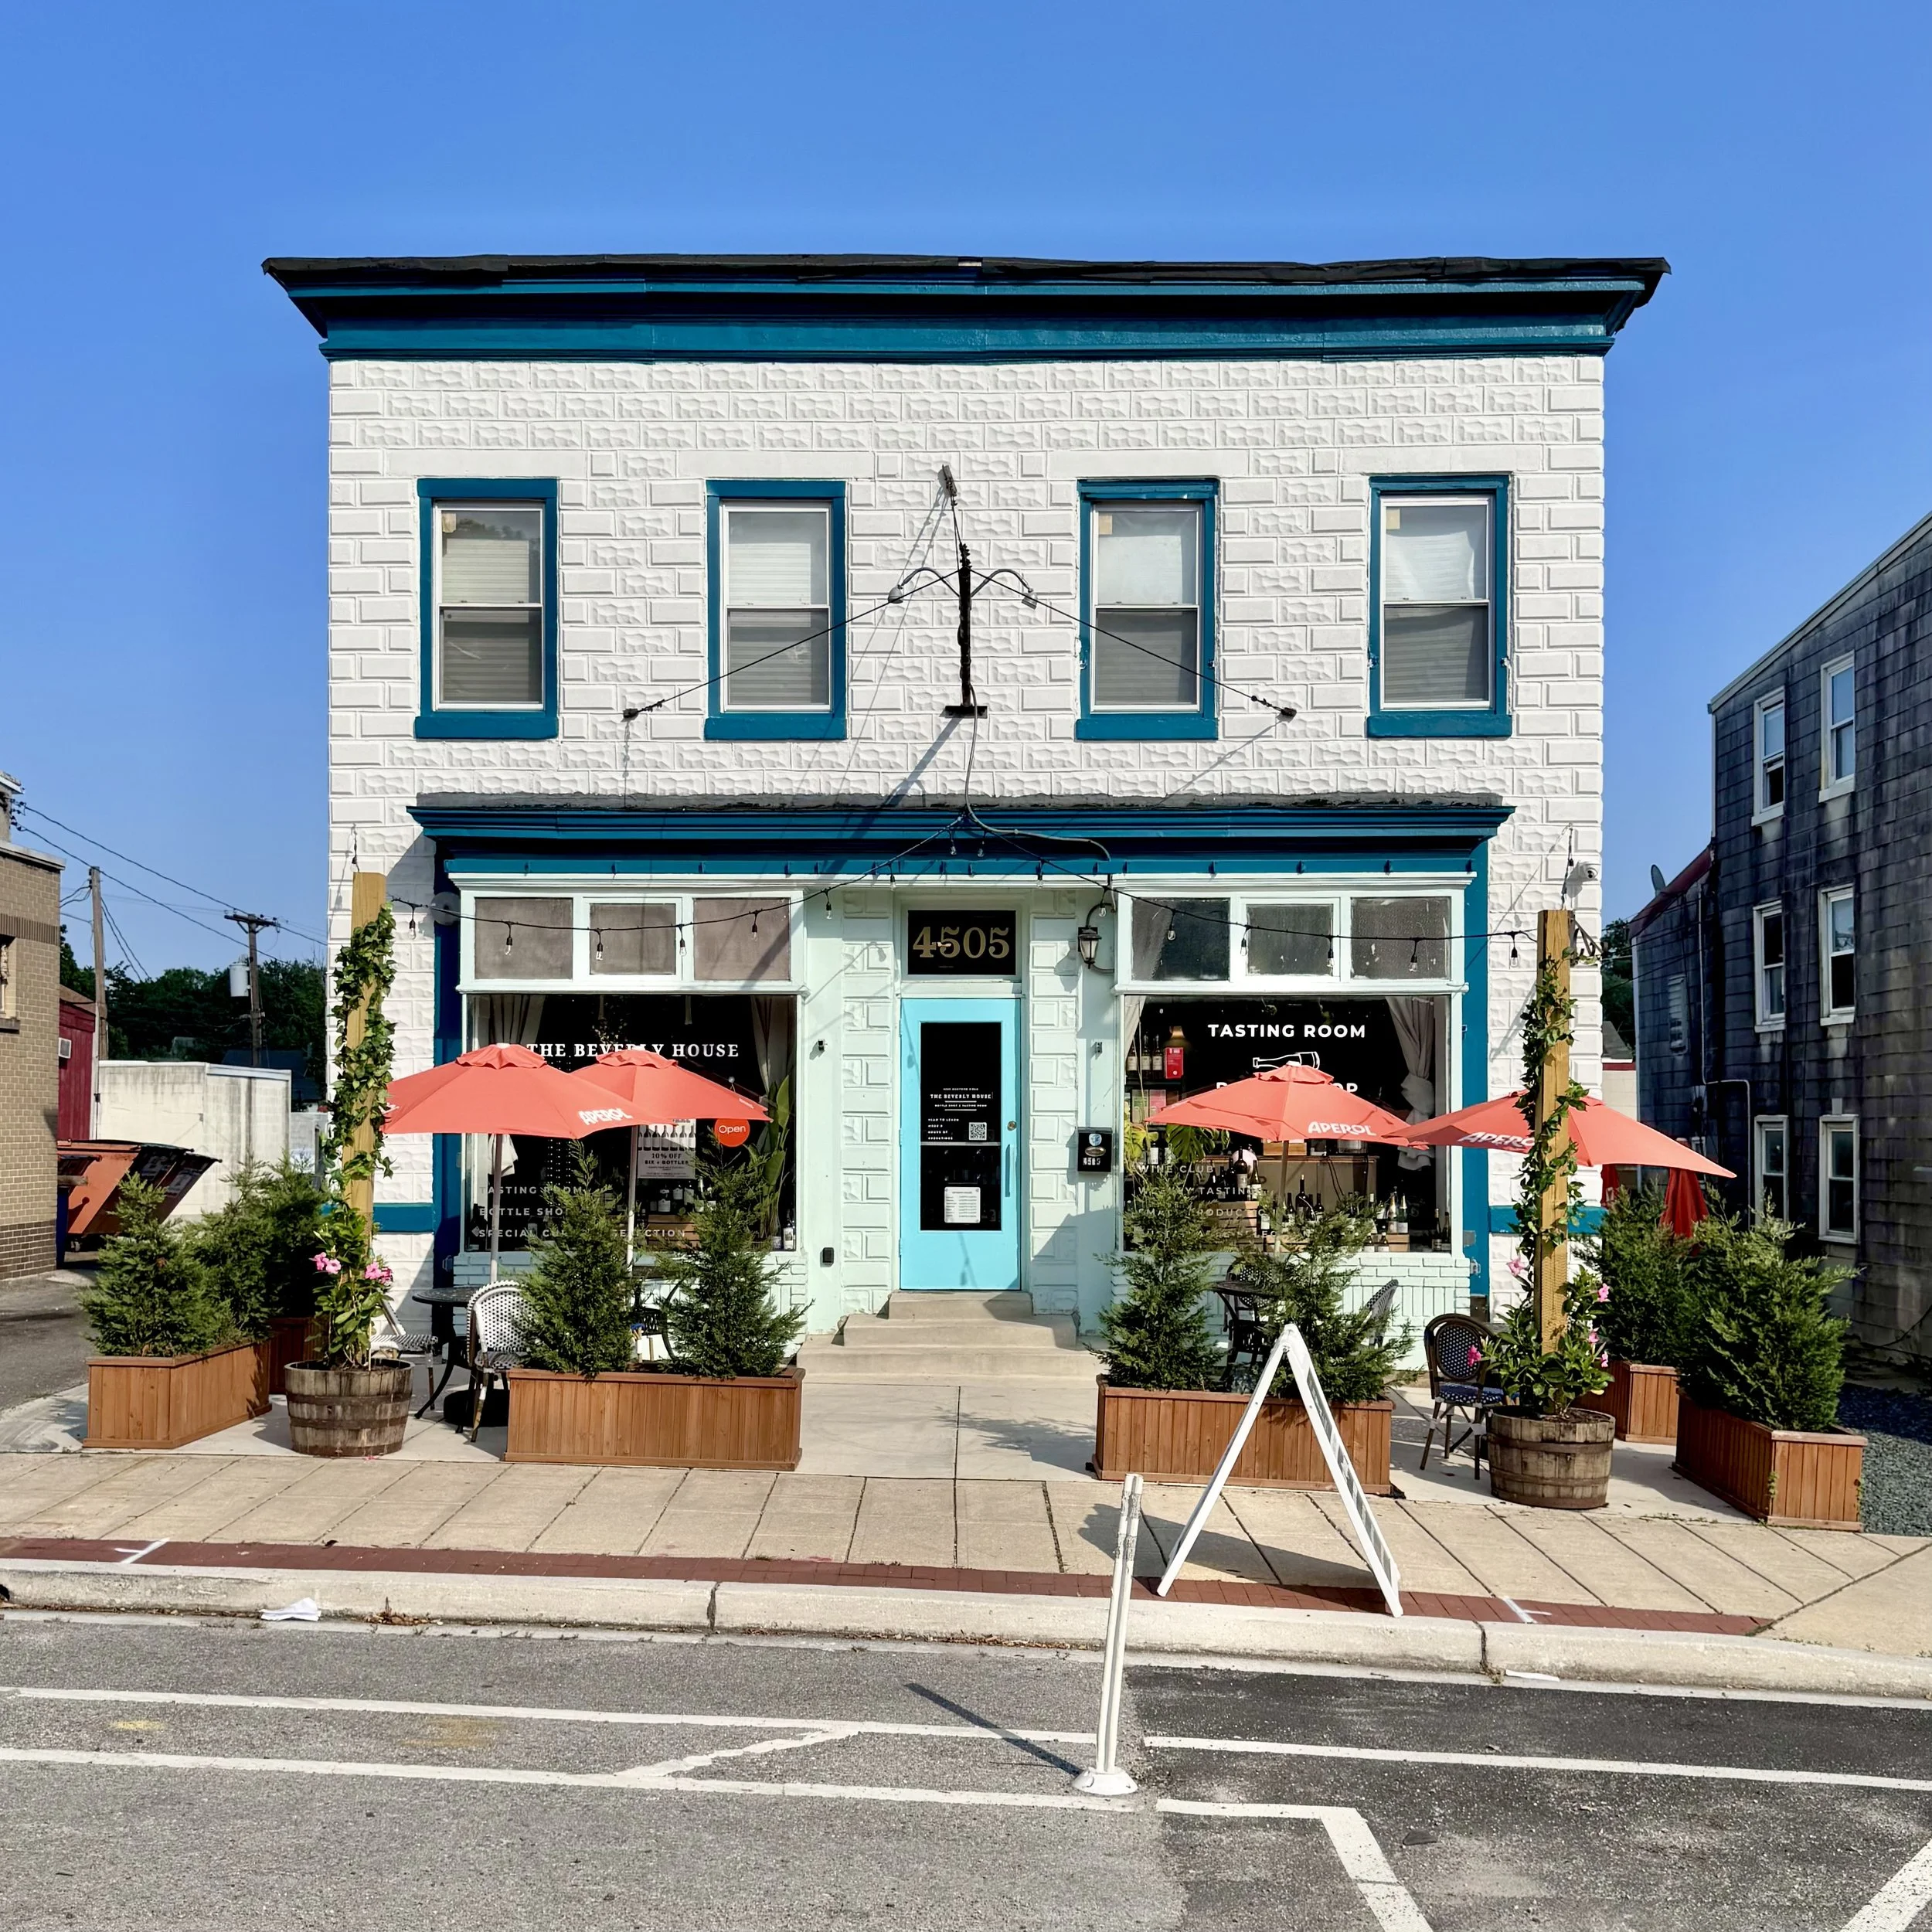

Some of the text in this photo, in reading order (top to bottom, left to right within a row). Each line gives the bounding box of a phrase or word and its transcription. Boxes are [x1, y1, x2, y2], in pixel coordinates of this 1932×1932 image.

[913, 927, 1009, 958] 4505
[1207, 1024, 1366, 1038] TASTING ROOM
[527, 1043, 566, 1056] THE
[672, 1044, 739, 1057] HOUSE
[578, 1107, 633, 1125] APEROL
[719, 1124, 746, 1134] Open
[1308, 1121, 1377, 1136] APEROL
[1457, 1131, 1536, 1147] APERO
